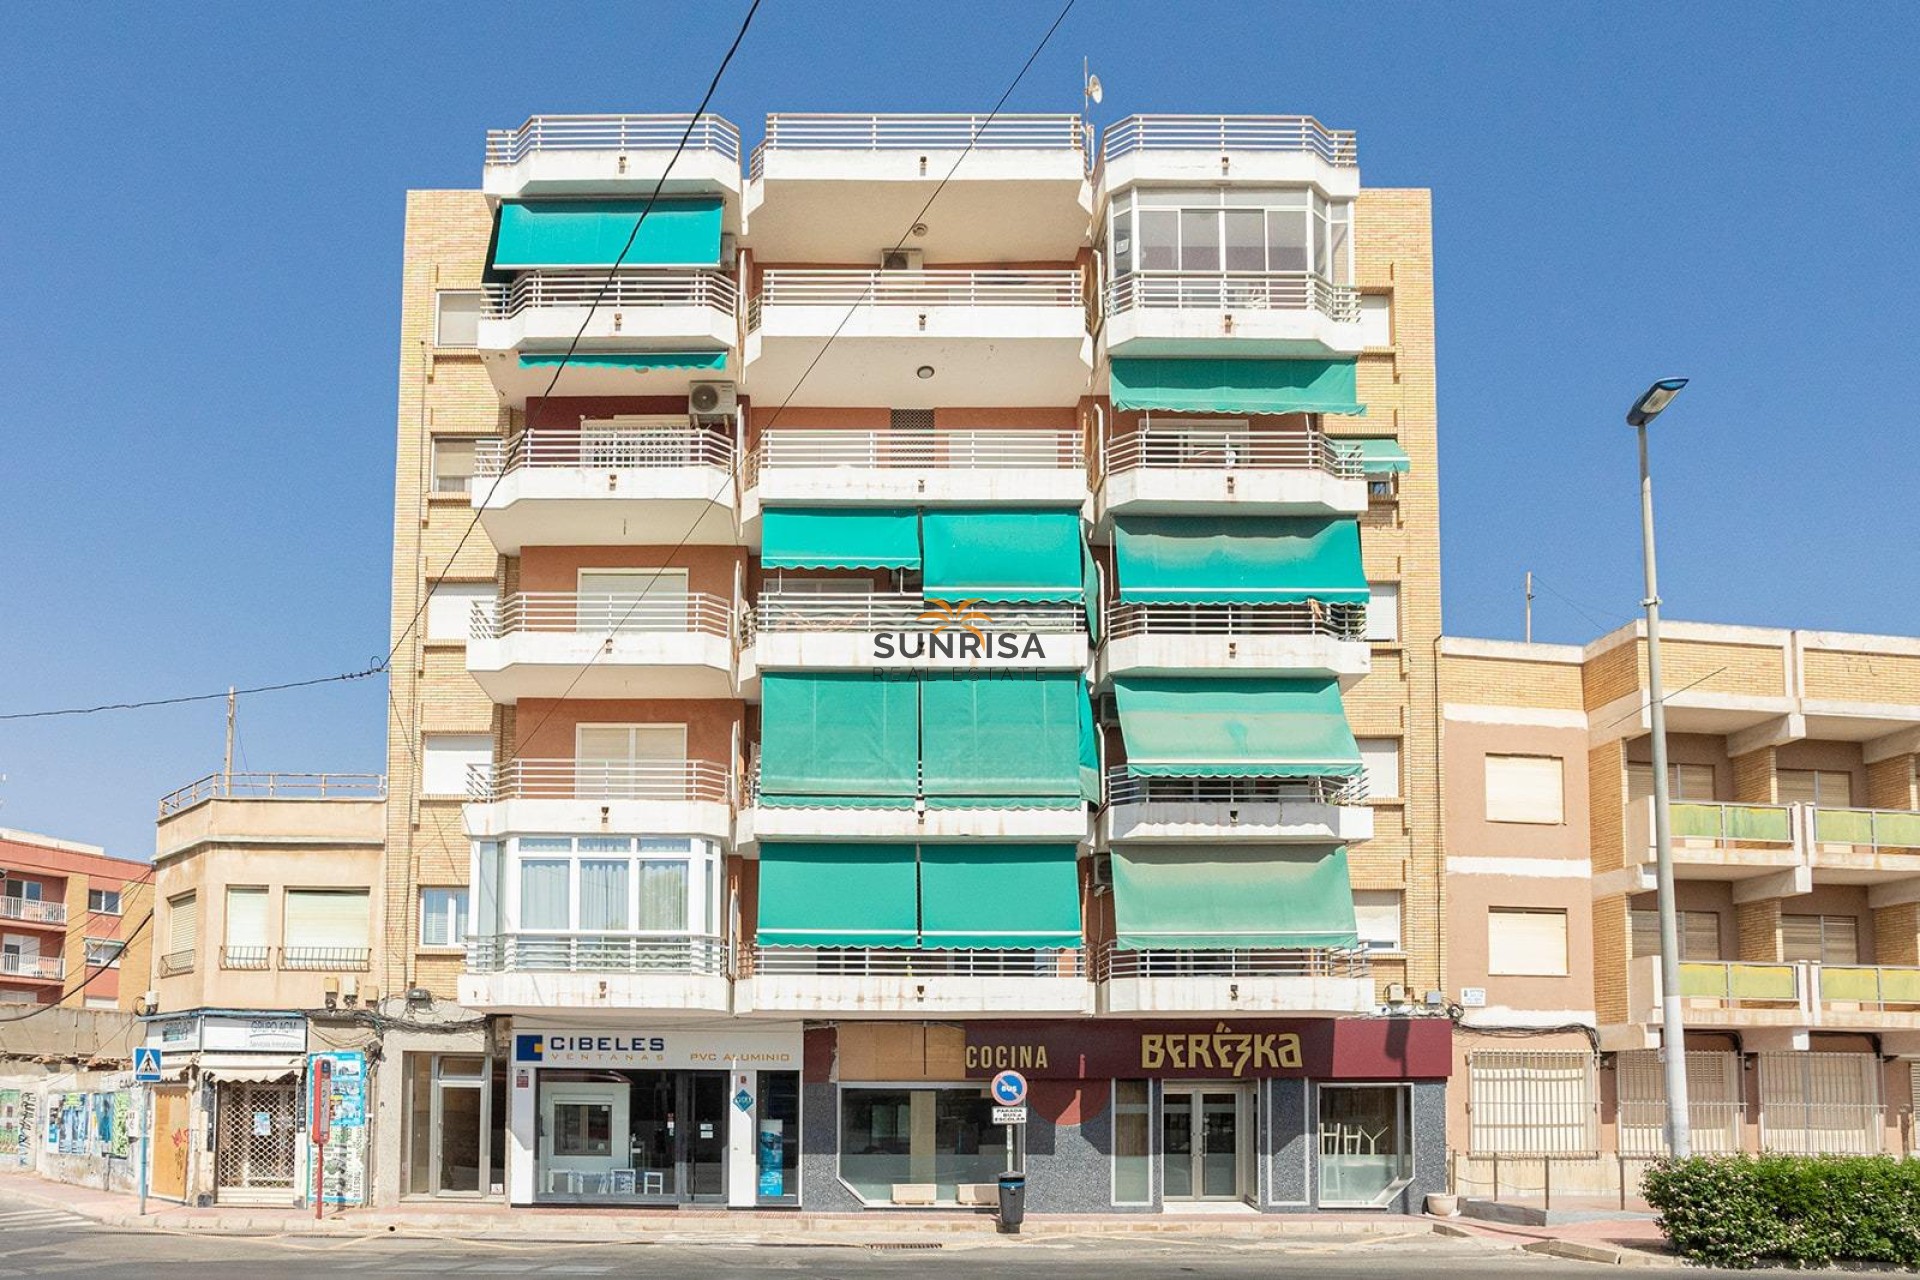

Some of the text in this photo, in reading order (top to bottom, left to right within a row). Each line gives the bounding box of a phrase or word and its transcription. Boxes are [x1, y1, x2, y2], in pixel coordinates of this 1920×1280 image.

[251, 1020, 277, 1033] GRUPO
[550, 1036, 665, 1051] CIBELES
[551, 1053, 664, 1061] VENTANAS
[690, 1053, 790, 1061] PVC ALUMINIO
[965, 1045, 1048, 1069] COCINA
